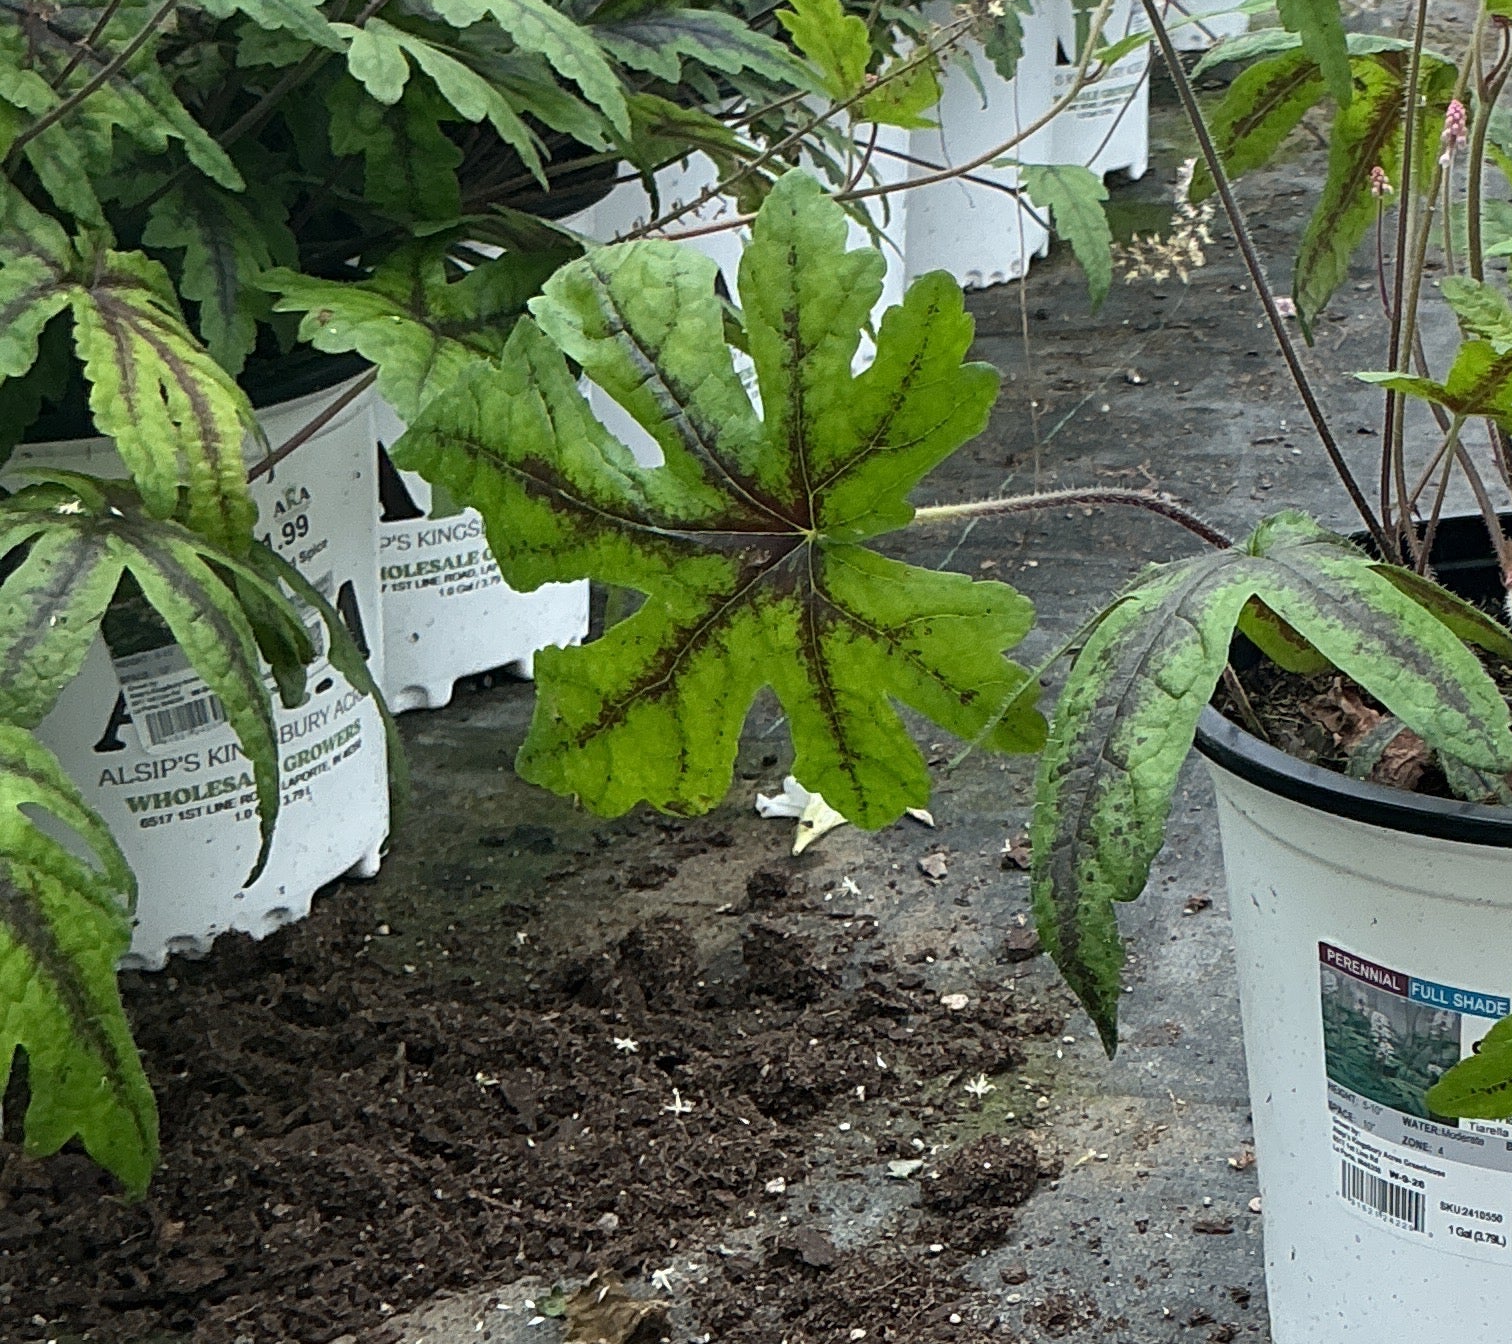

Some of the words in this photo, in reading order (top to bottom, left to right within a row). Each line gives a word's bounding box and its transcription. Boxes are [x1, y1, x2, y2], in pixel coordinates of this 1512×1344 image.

[283, 718, 361, 773] GROWERS
[98, 753, 201, 788] ALSIP'S
[1326, 948, 1402, 992] PERENNIAL
[1411, 981, 1450, 1006] FULL
[1452, 992, 1509, 1017] SHADE
[1441, 1128, 1485, 1147] Moderate
[1468, 1121, 1510, 1138] Tiarella
[1401, 1135, 1432, 1152] ZONE:
[1456, 1226, 1473, 1240] Gal
